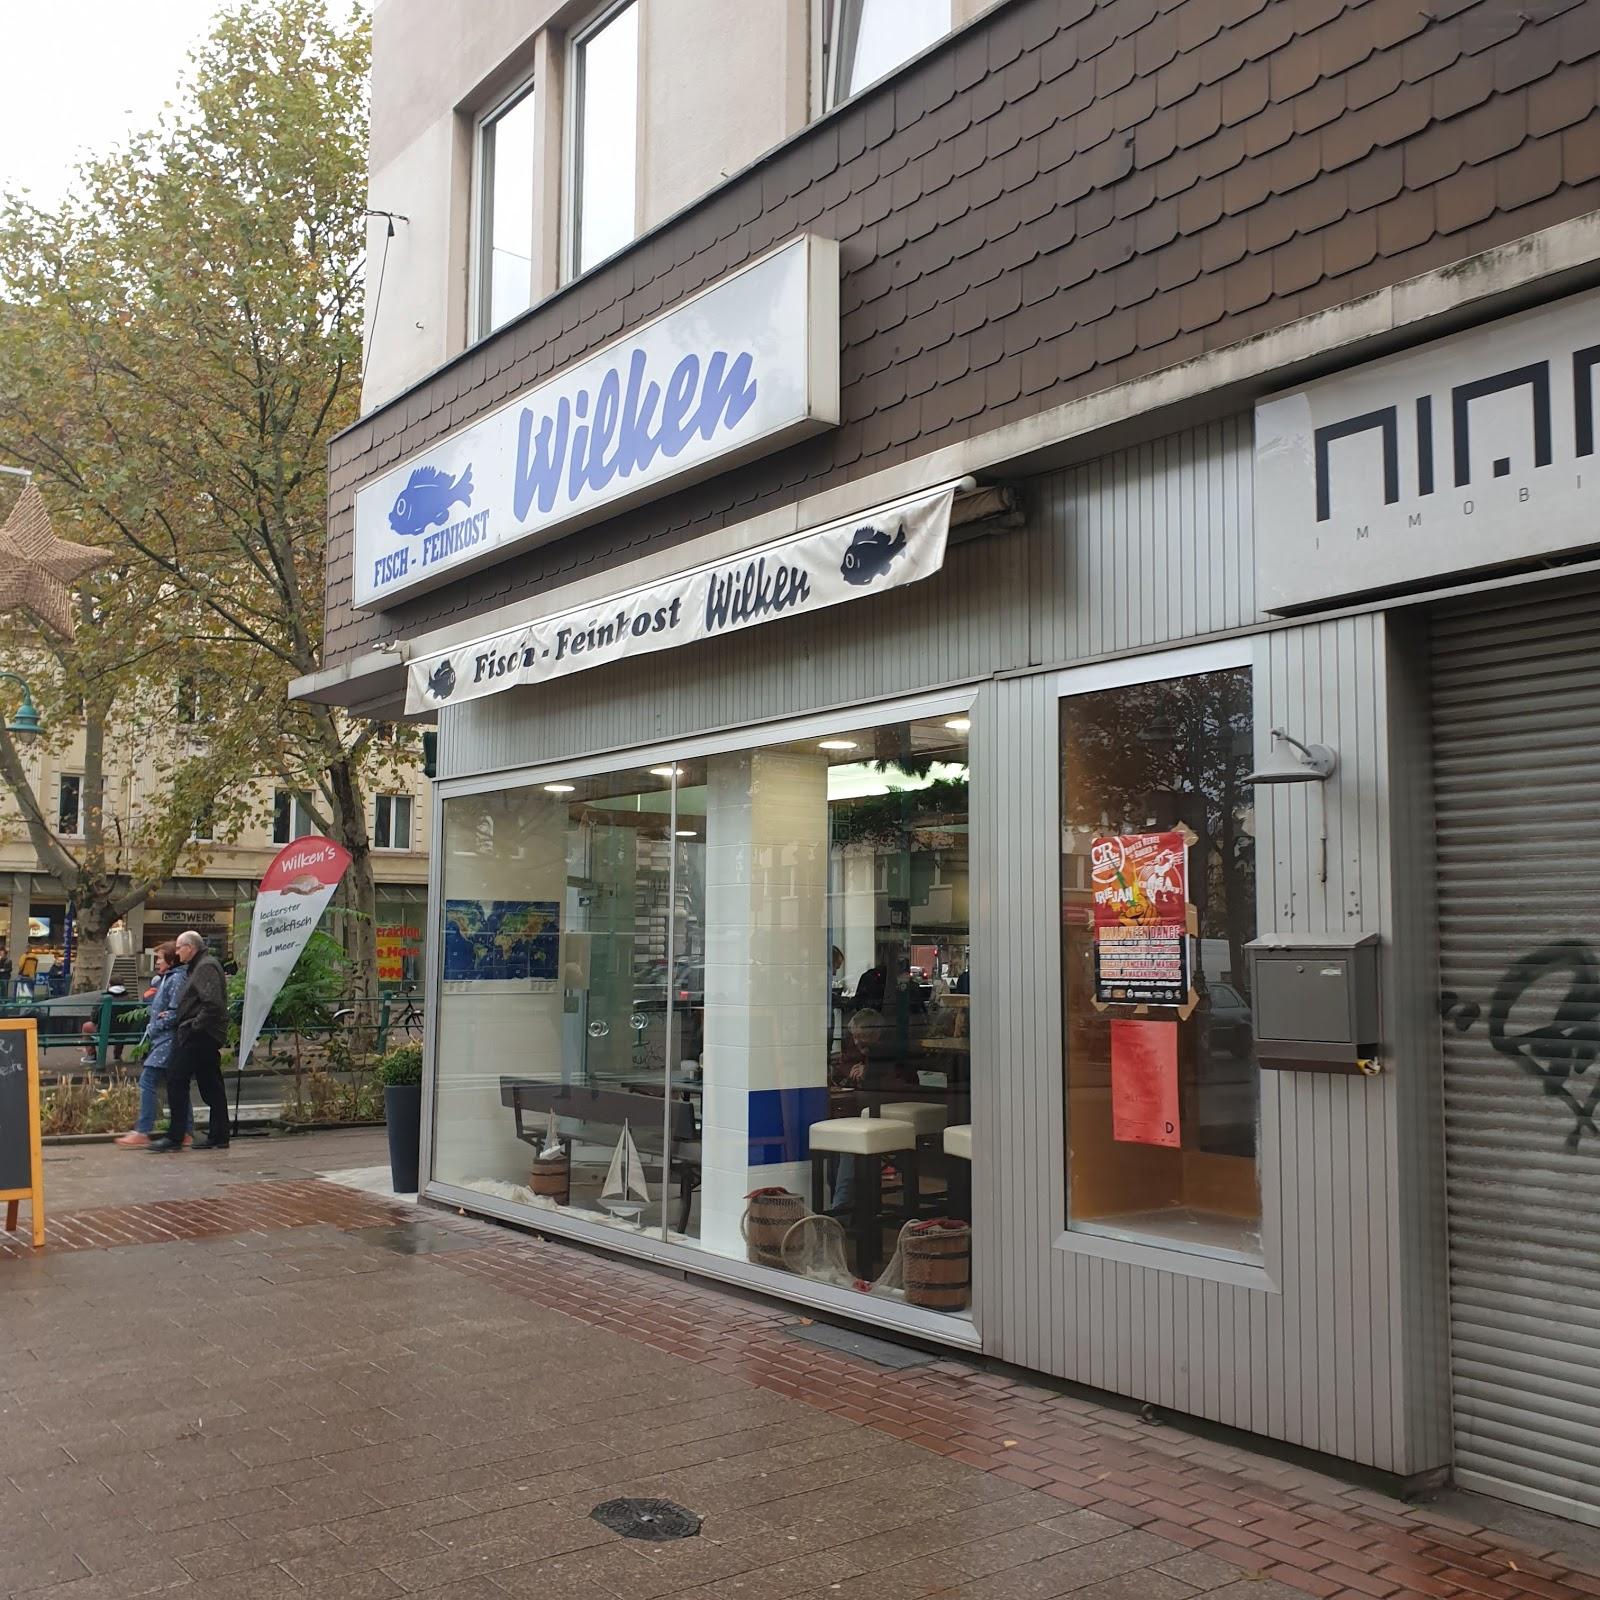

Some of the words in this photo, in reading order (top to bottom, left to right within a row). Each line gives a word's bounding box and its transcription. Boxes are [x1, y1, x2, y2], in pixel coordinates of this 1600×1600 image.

[513, 349, 757, 523] Wilken
[373, 548, 409, 588] FISCH
[422, 509, 490, 567] FEINKOST
[555, 597, 682, 661] Feinkost
[705, 557, 811, 632] Wilken
[281, 846, 336, 873] Wilken's
[260, 903, 302, 921] leckerster
[265, 915, 313, 938] Backfisch
[257, 947, 273, 959] und
